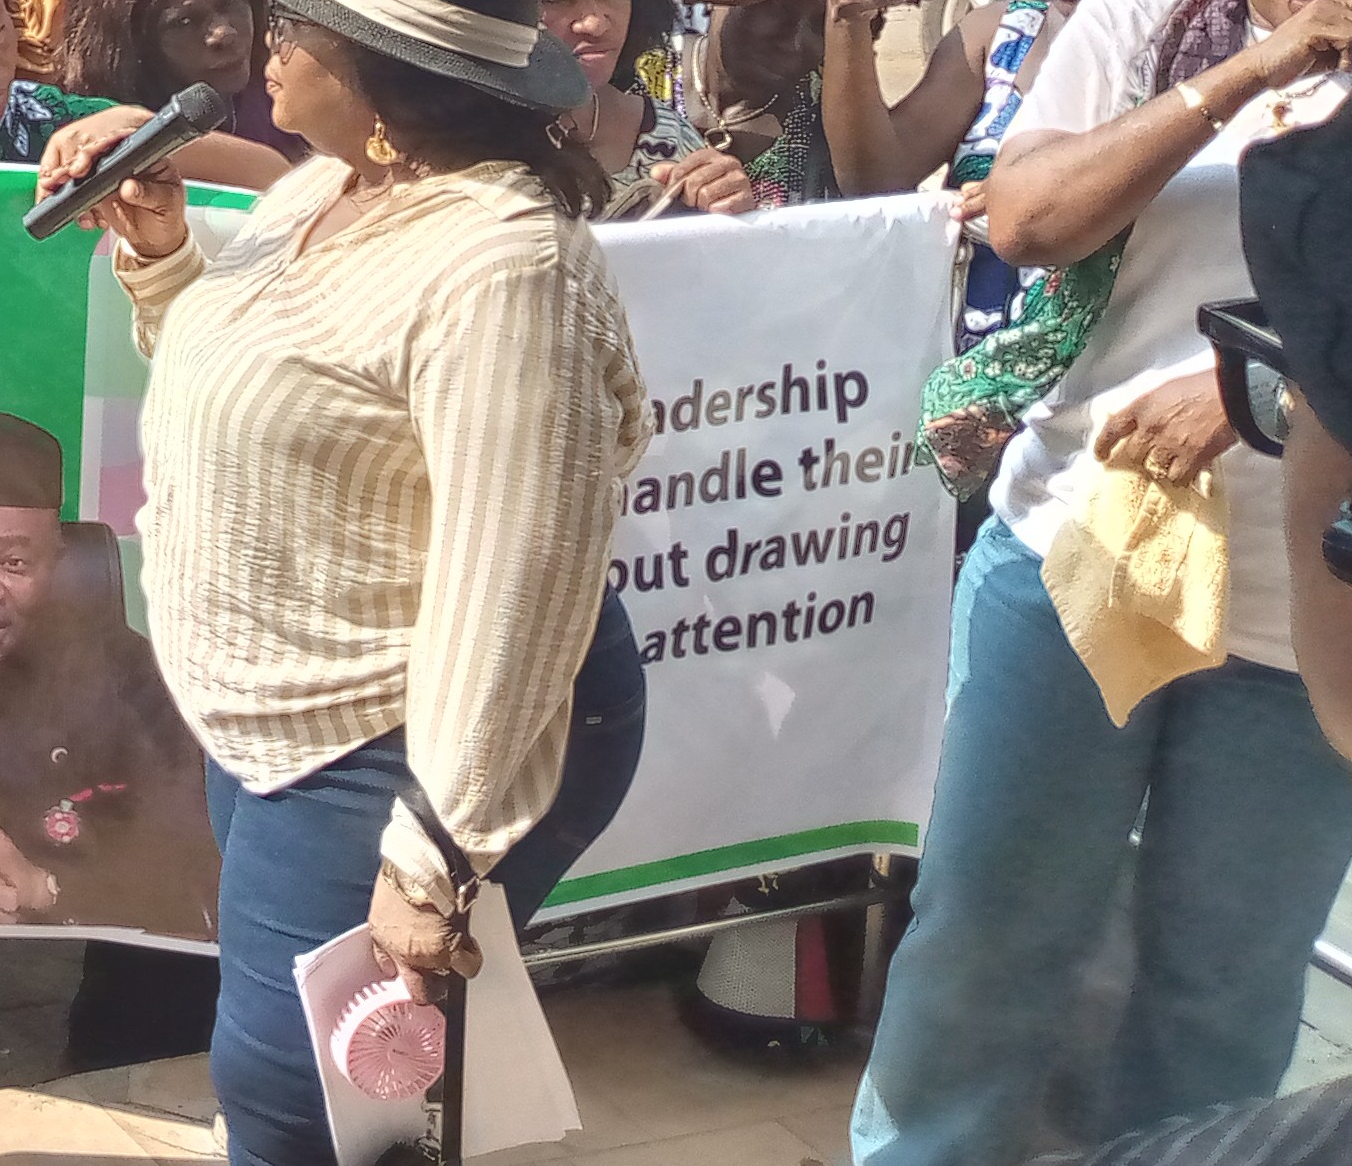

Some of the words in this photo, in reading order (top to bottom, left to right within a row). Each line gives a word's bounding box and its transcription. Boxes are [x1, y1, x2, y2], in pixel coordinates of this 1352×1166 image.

[620, 447, 784, 518] andle
[705, 511, 911, 584] drawing
[638, 589, 876, 666] attention
